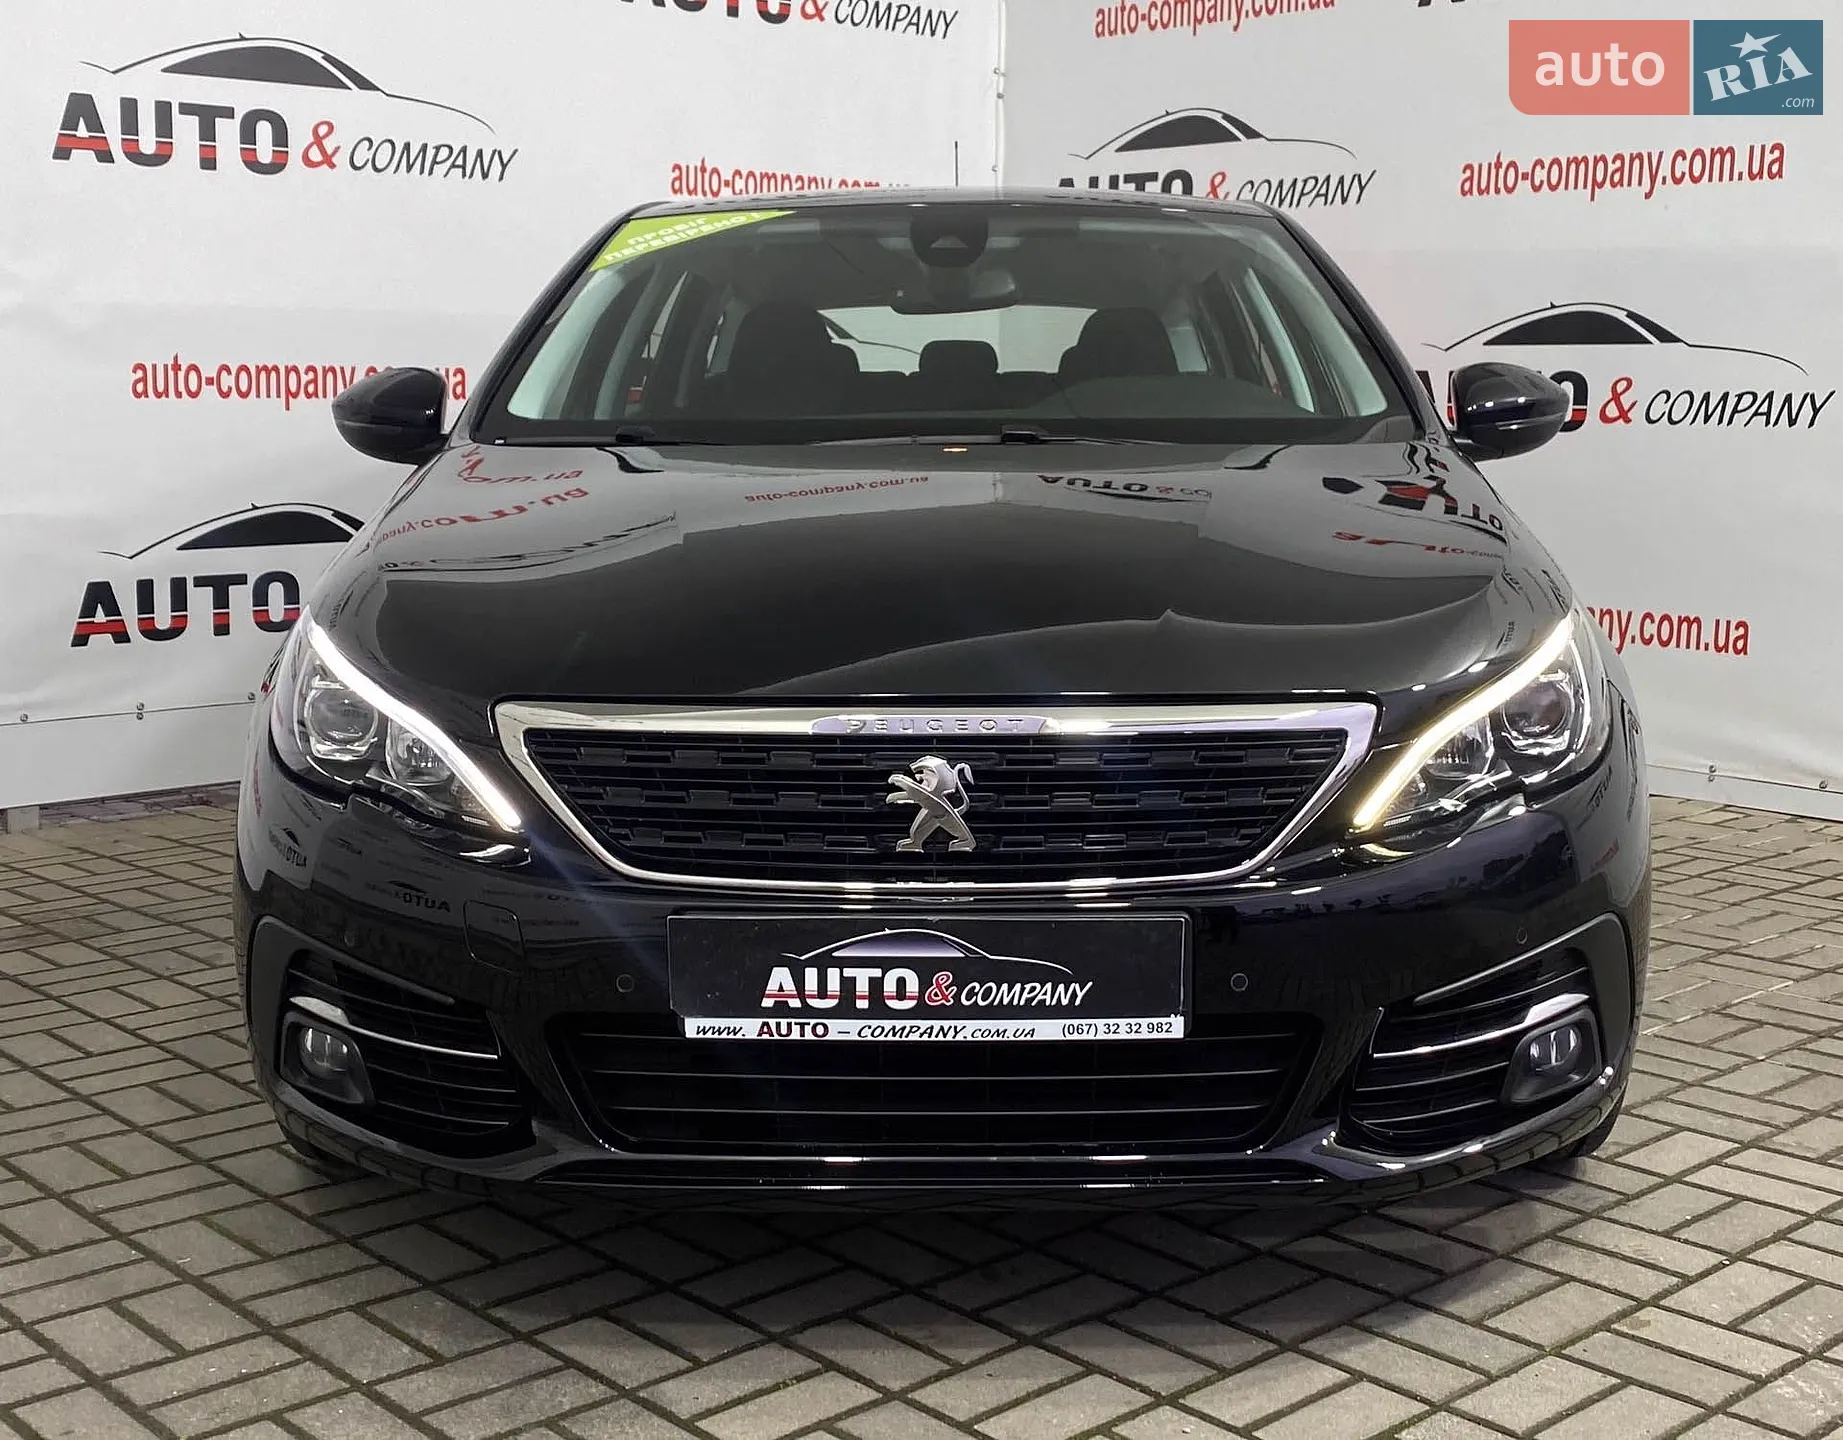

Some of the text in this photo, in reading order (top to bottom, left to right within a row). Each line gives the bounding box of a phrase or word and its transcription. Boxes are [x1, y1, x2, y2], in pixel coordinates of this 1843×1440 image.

[834, 0, 958, 40] COMPANY
[51, 91, 519, 182] AUTO & COMPANY
[1236, 169, 1378, 209] COMPANY
[1460, 142, 1786, 202] auto-company.com.ua
[1600, 377, 1638, 424] &
[1645, 390, 1836, 429] COMPANY
[70, 570, 300, 647] AUTO
[848, 718, 1024, 734] PEUGEOT
[760, 966, 1093, 1010] AUTO & COMPANY
[696, 1024, 746, 1038] www.
[757, 1021, 829, 1038] AUTO
[1062, 1022, 1099, 1037] (067)
[1103, 1022, 1121, 1035] 32
[1125, 1022, 1142, 1034] 32
[1146, 1022, 1173, 1034] 982
